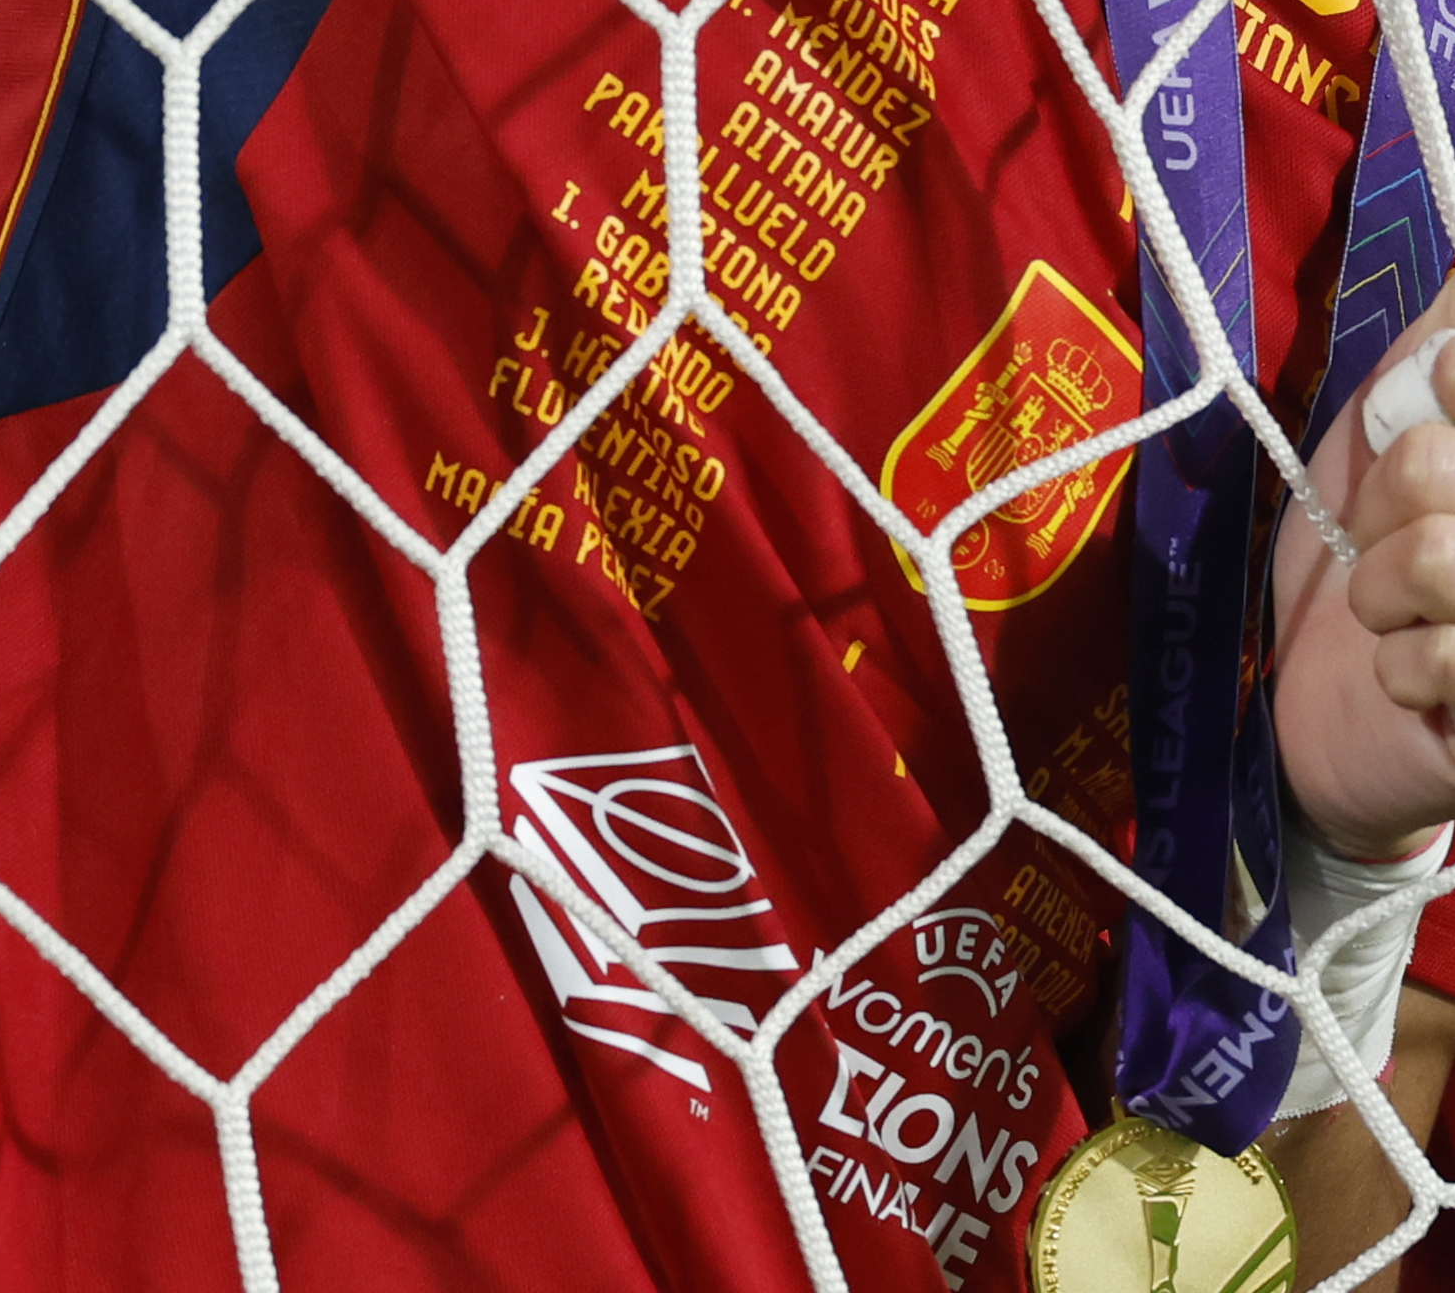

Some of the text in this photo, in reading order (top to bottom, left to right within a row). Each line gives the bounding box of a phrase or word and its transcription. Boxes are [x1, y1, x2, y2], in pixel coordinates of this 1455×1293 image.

[742, 49, 900, 192] AMAIUR
[551, 179, 582, 231] I.
[720, 101, 867, 239] AITANA
[514, 306, 550, 359] J.
[915, 923, 1019, 1010] UEFA
